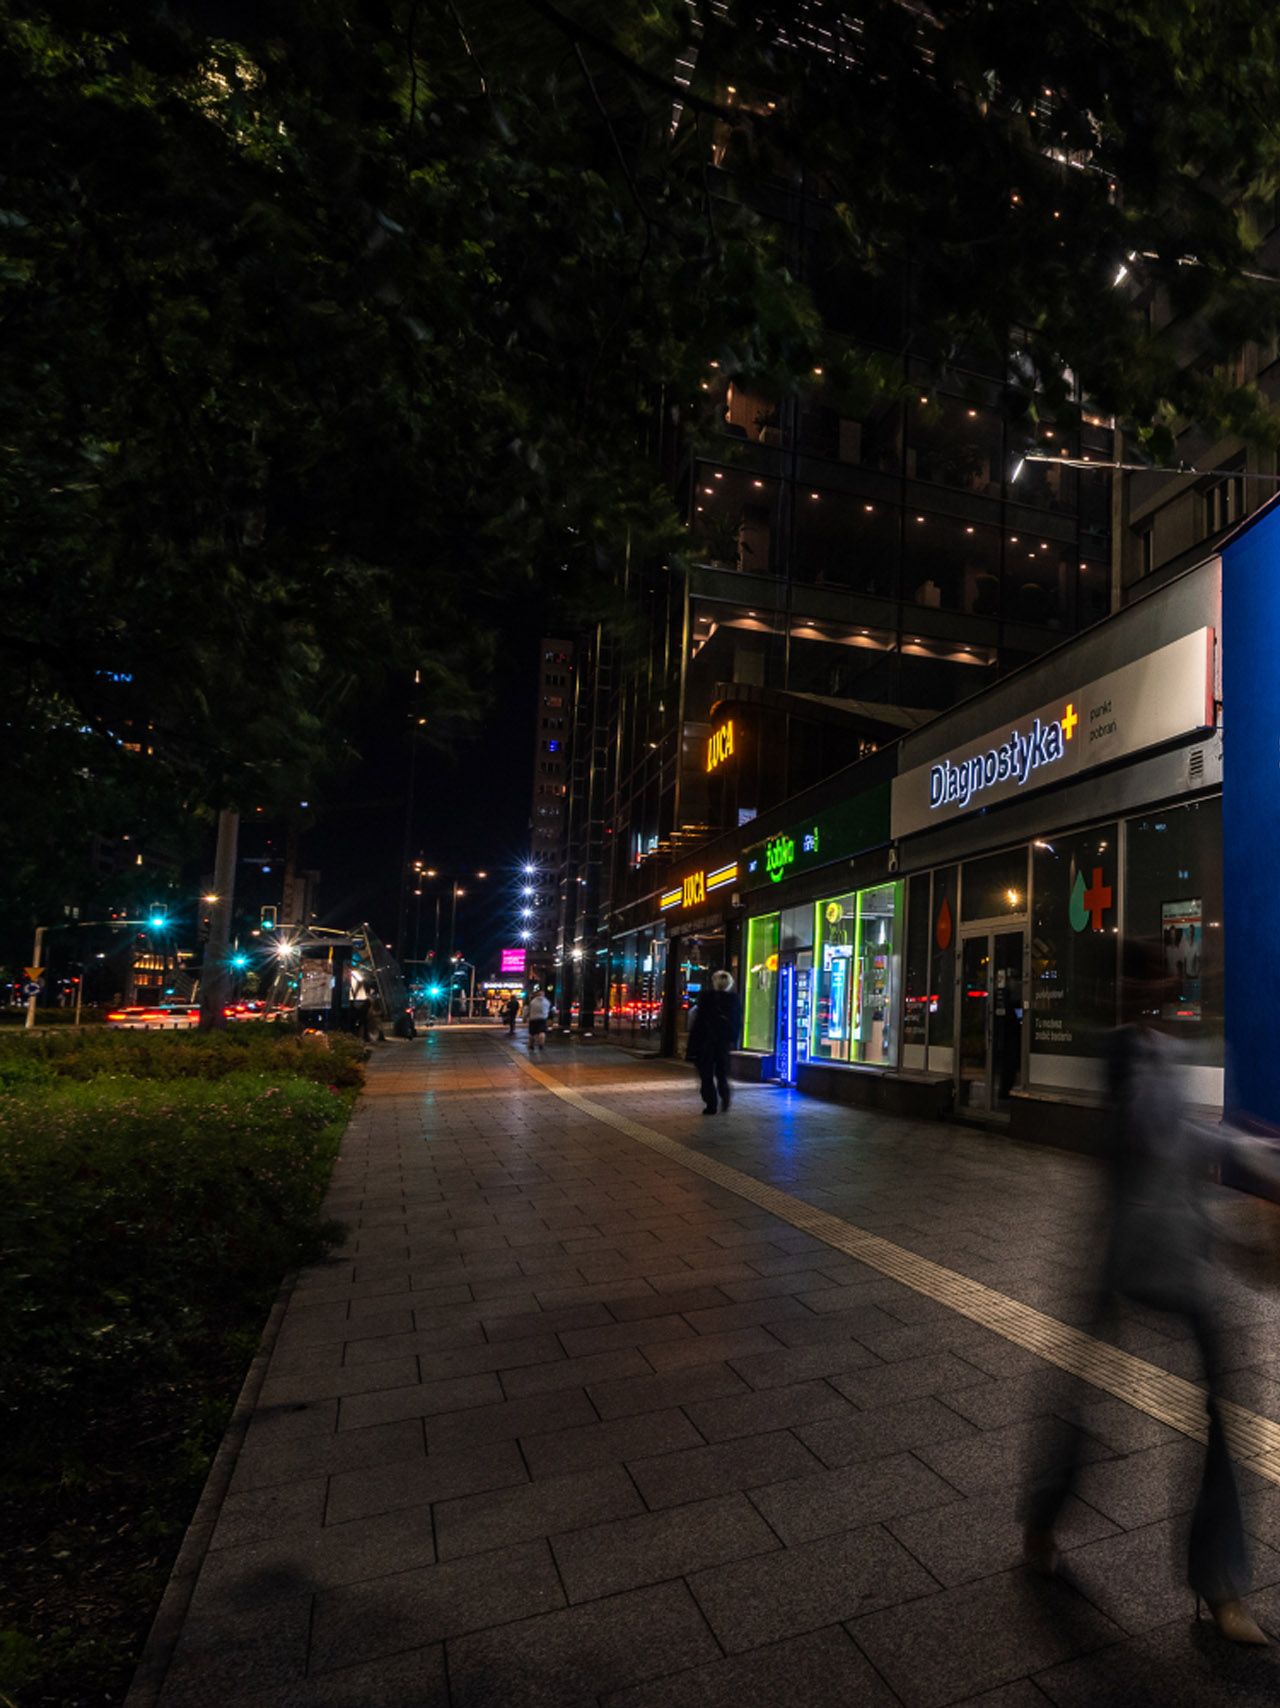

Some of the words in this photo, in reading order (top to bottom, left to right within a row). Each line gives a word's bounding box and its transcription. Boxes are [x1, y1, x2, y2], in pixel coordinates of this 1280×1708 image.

[1090, 698, 1112, 723] punkt
[706, 720, 734, 773] LUCA
[930, 718, 1064, 809] Diagnostyka
[682, 870, 706, 909] LUCA
